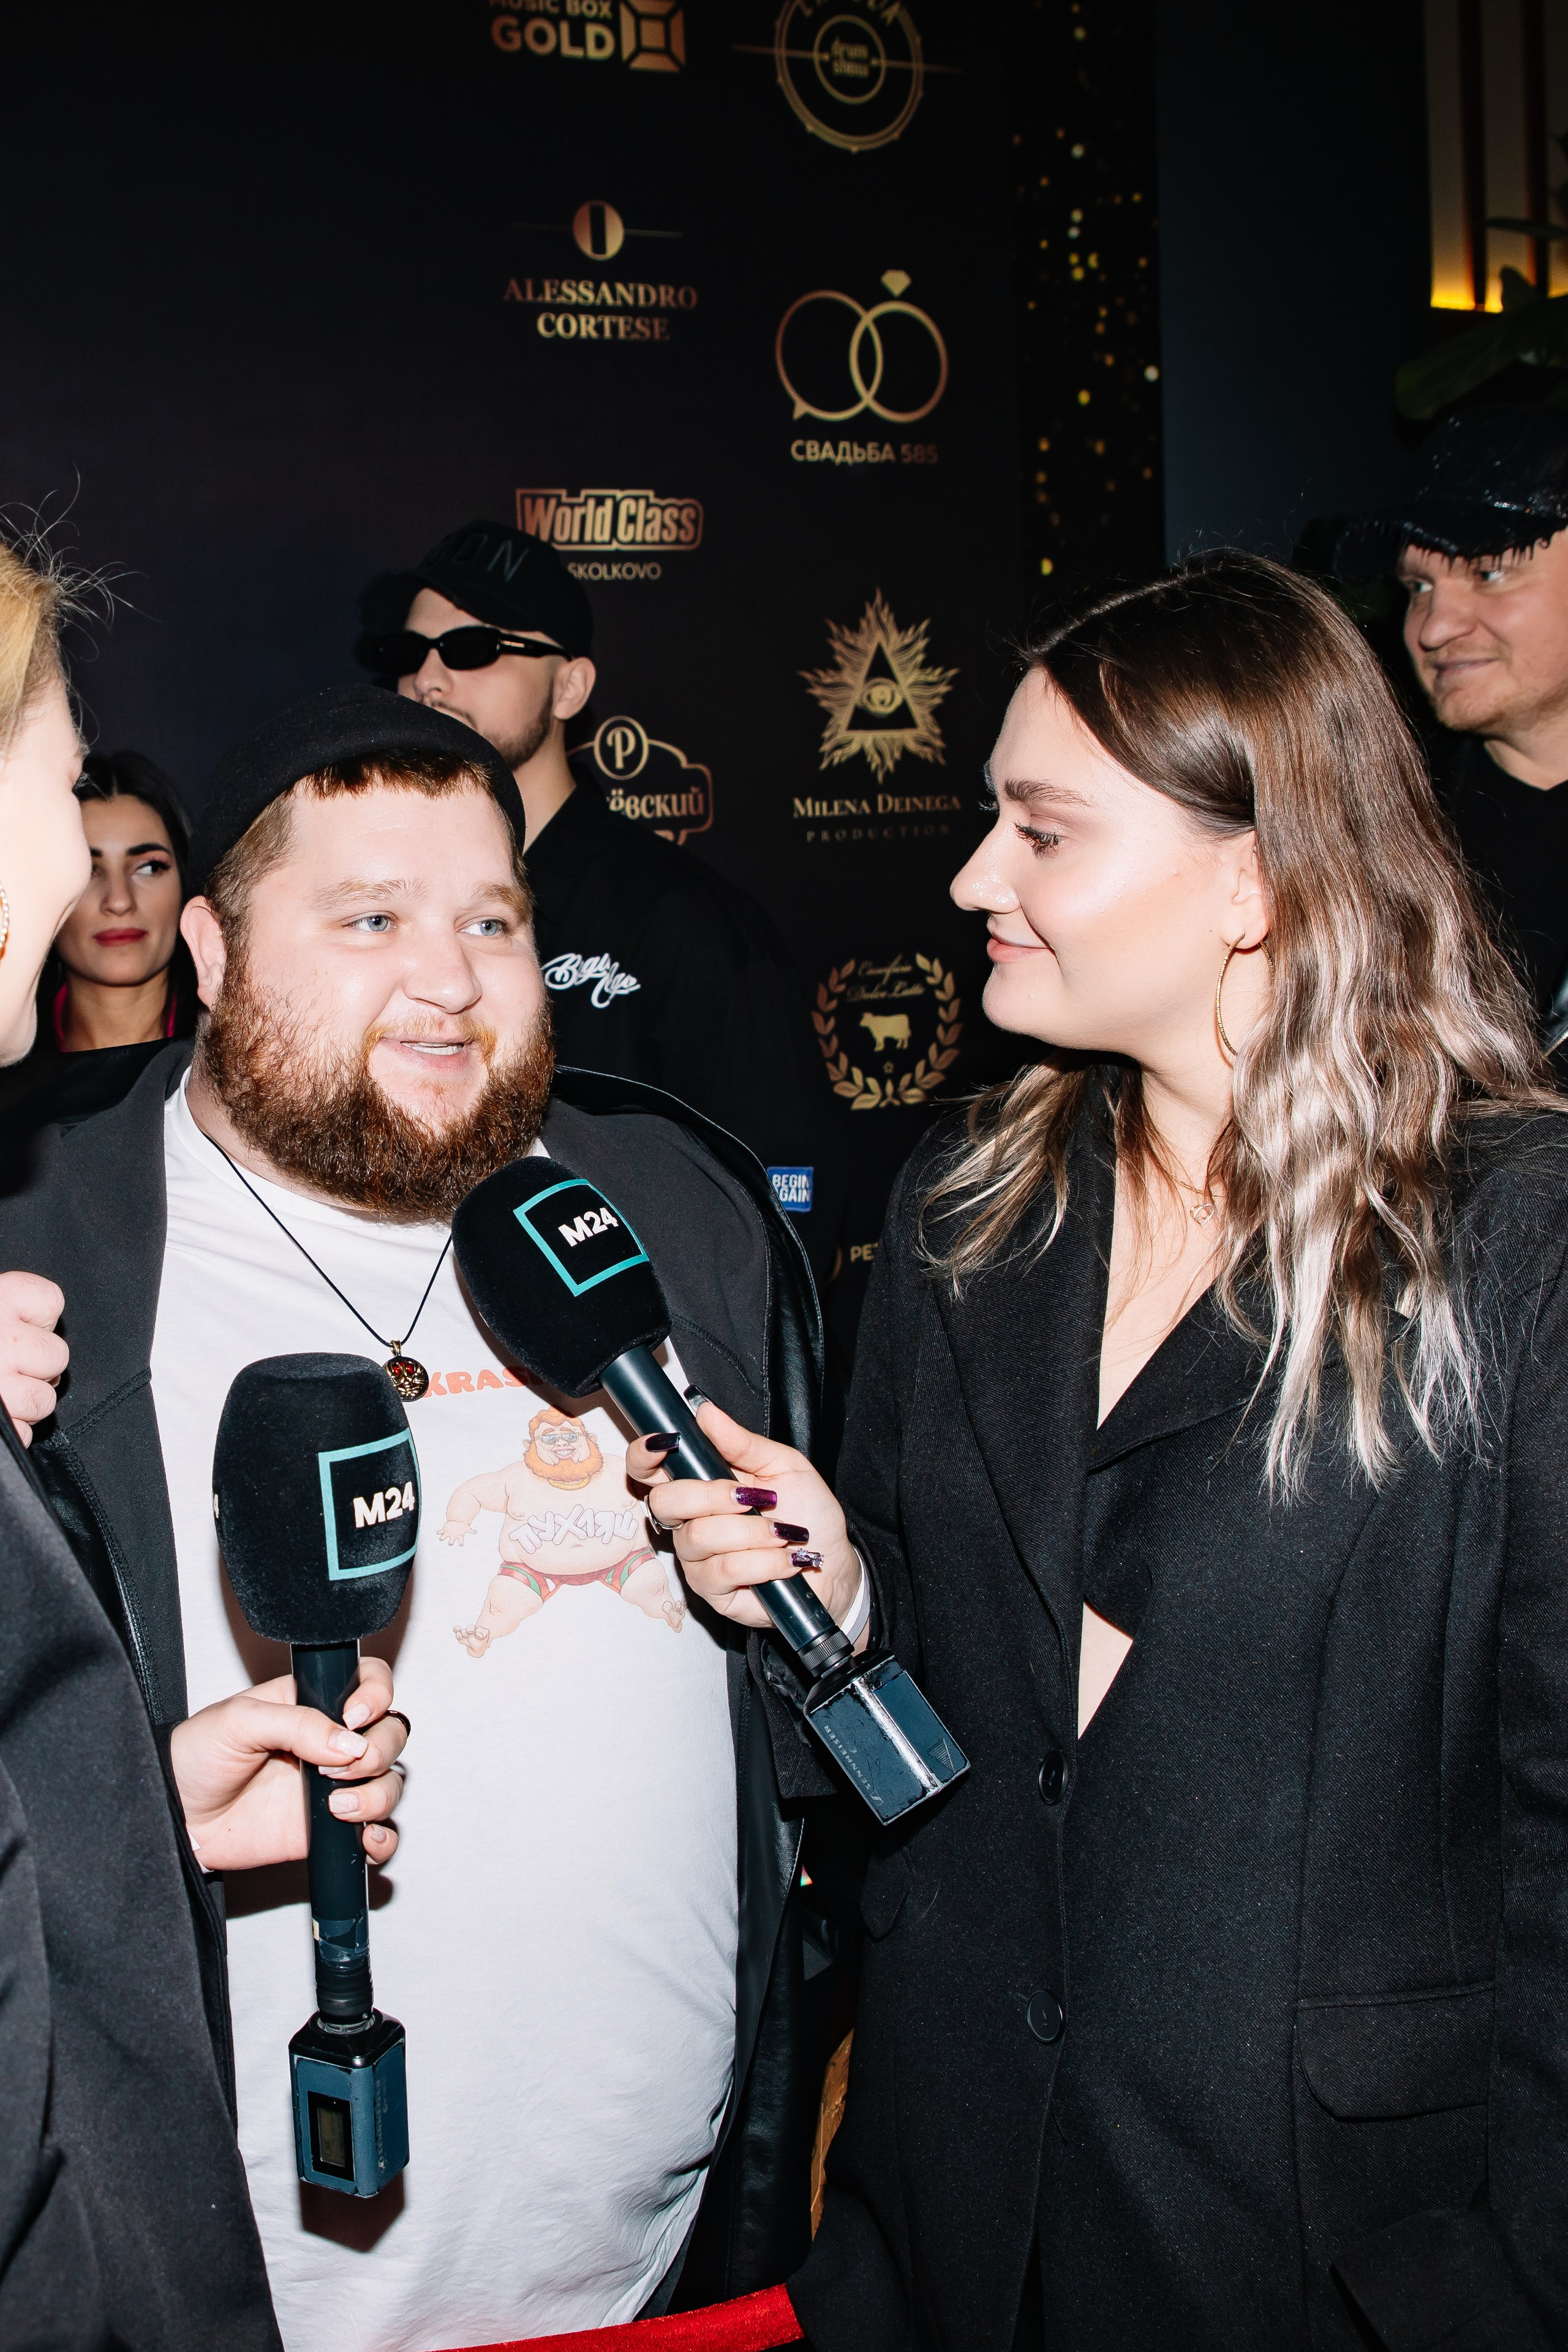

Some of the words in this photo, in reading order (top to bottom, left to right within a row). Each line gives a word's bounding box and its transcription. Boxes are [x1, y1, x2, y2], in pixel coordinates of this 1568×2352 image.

[566, 0, 612, 20] BOX
[491, 13, 615, 60] GOLD
[503, 277, 698, 310] ALESSANDRO
[537, 312, 671, 341] CORTESE
[790, 439, 895, 466] СВАДЬБА
[900, 443, 939, 464] 585
[524, 497, 613, 543] World
[617, 497, 696, 543] Class
[567, 561, 662, 581] SKOLKOVO
[606, 786, 704, 820] ёвский
[793, 796, 871, 818] MILENA
[806, 824, 950, 843] PRODUCTION
[772, 1174, 810, 1189] BEGIN
[558, 1207, 619, 1247] M24
[850, 1242, 879, 1263] PE
[353, 1481, 415, 1528] M24
[824, 1725, 872, 1790] SENNHEISER
